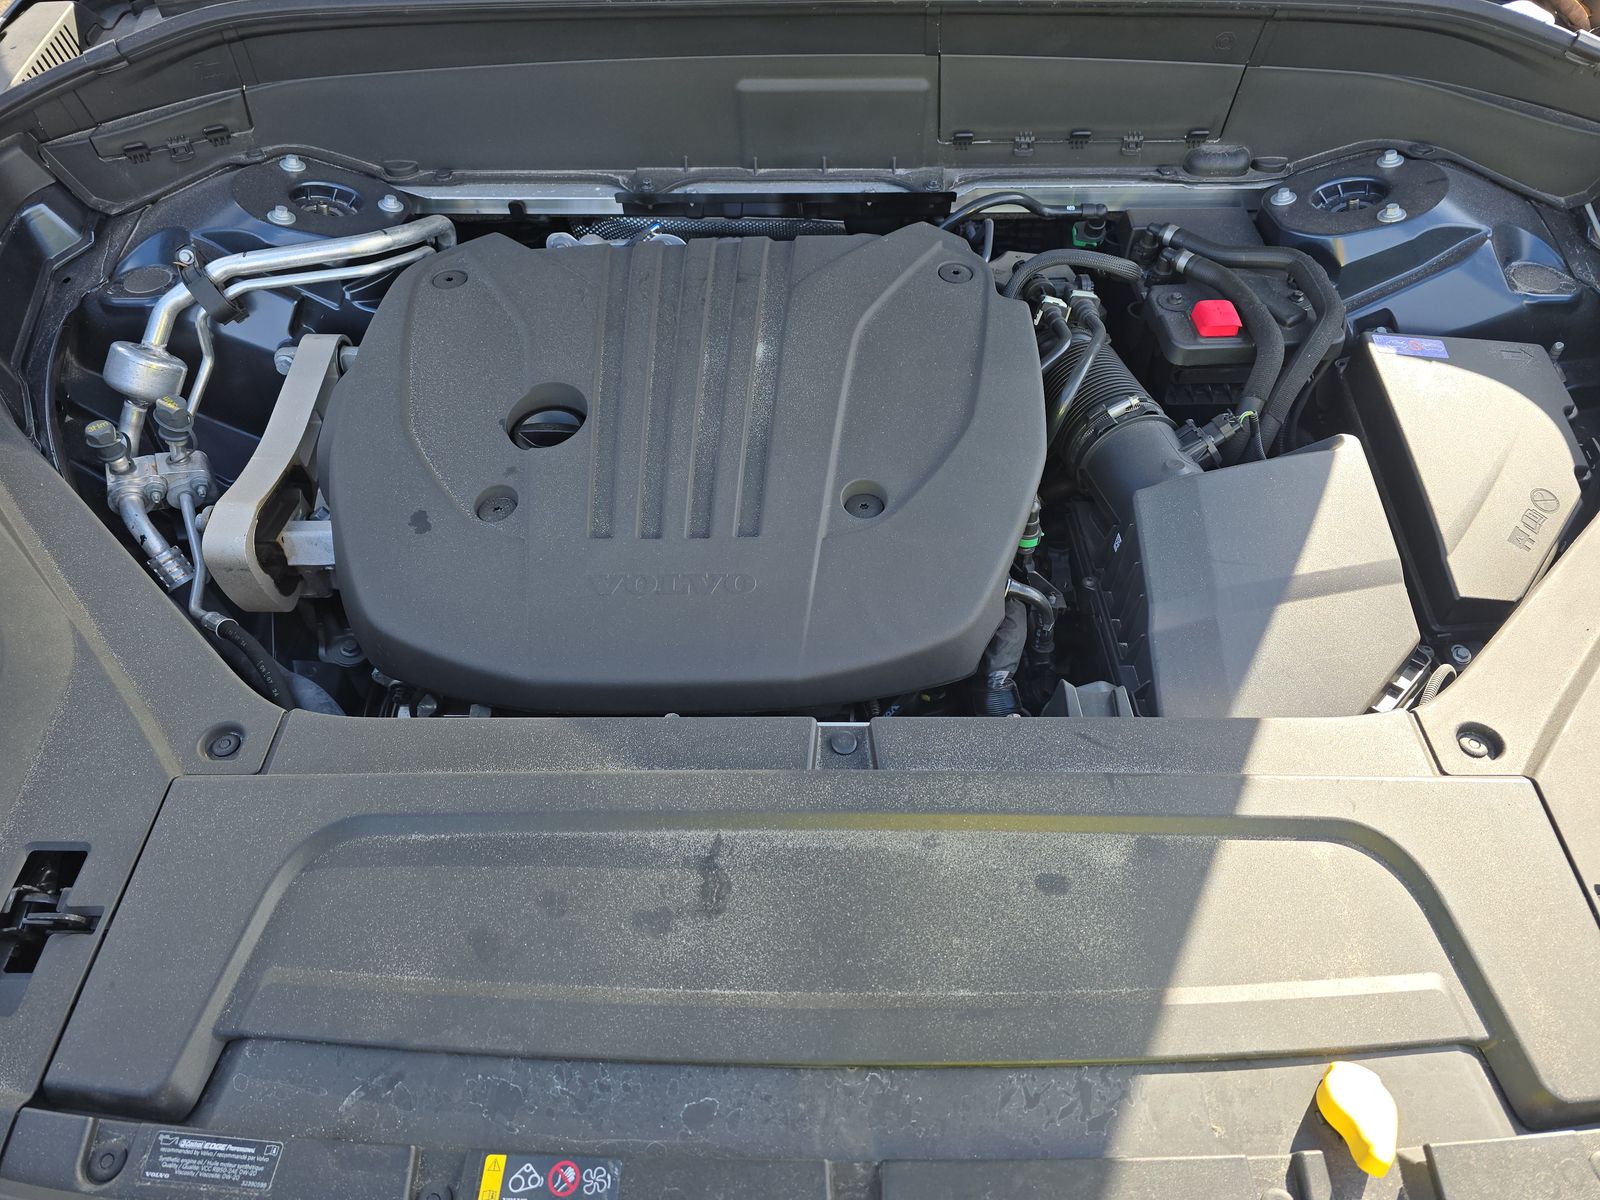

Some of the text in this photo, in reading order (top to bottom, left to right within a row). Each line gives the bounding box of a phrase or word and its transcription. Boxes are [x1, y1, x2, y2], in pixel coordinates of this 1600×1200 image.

[587, 573, 757, 596] VOLVO
[203, 1142, 227, 1151] EDGE
[161, 1161, 179, 1169] Quality
[145, 1171, 170, 1179] VOLVO
